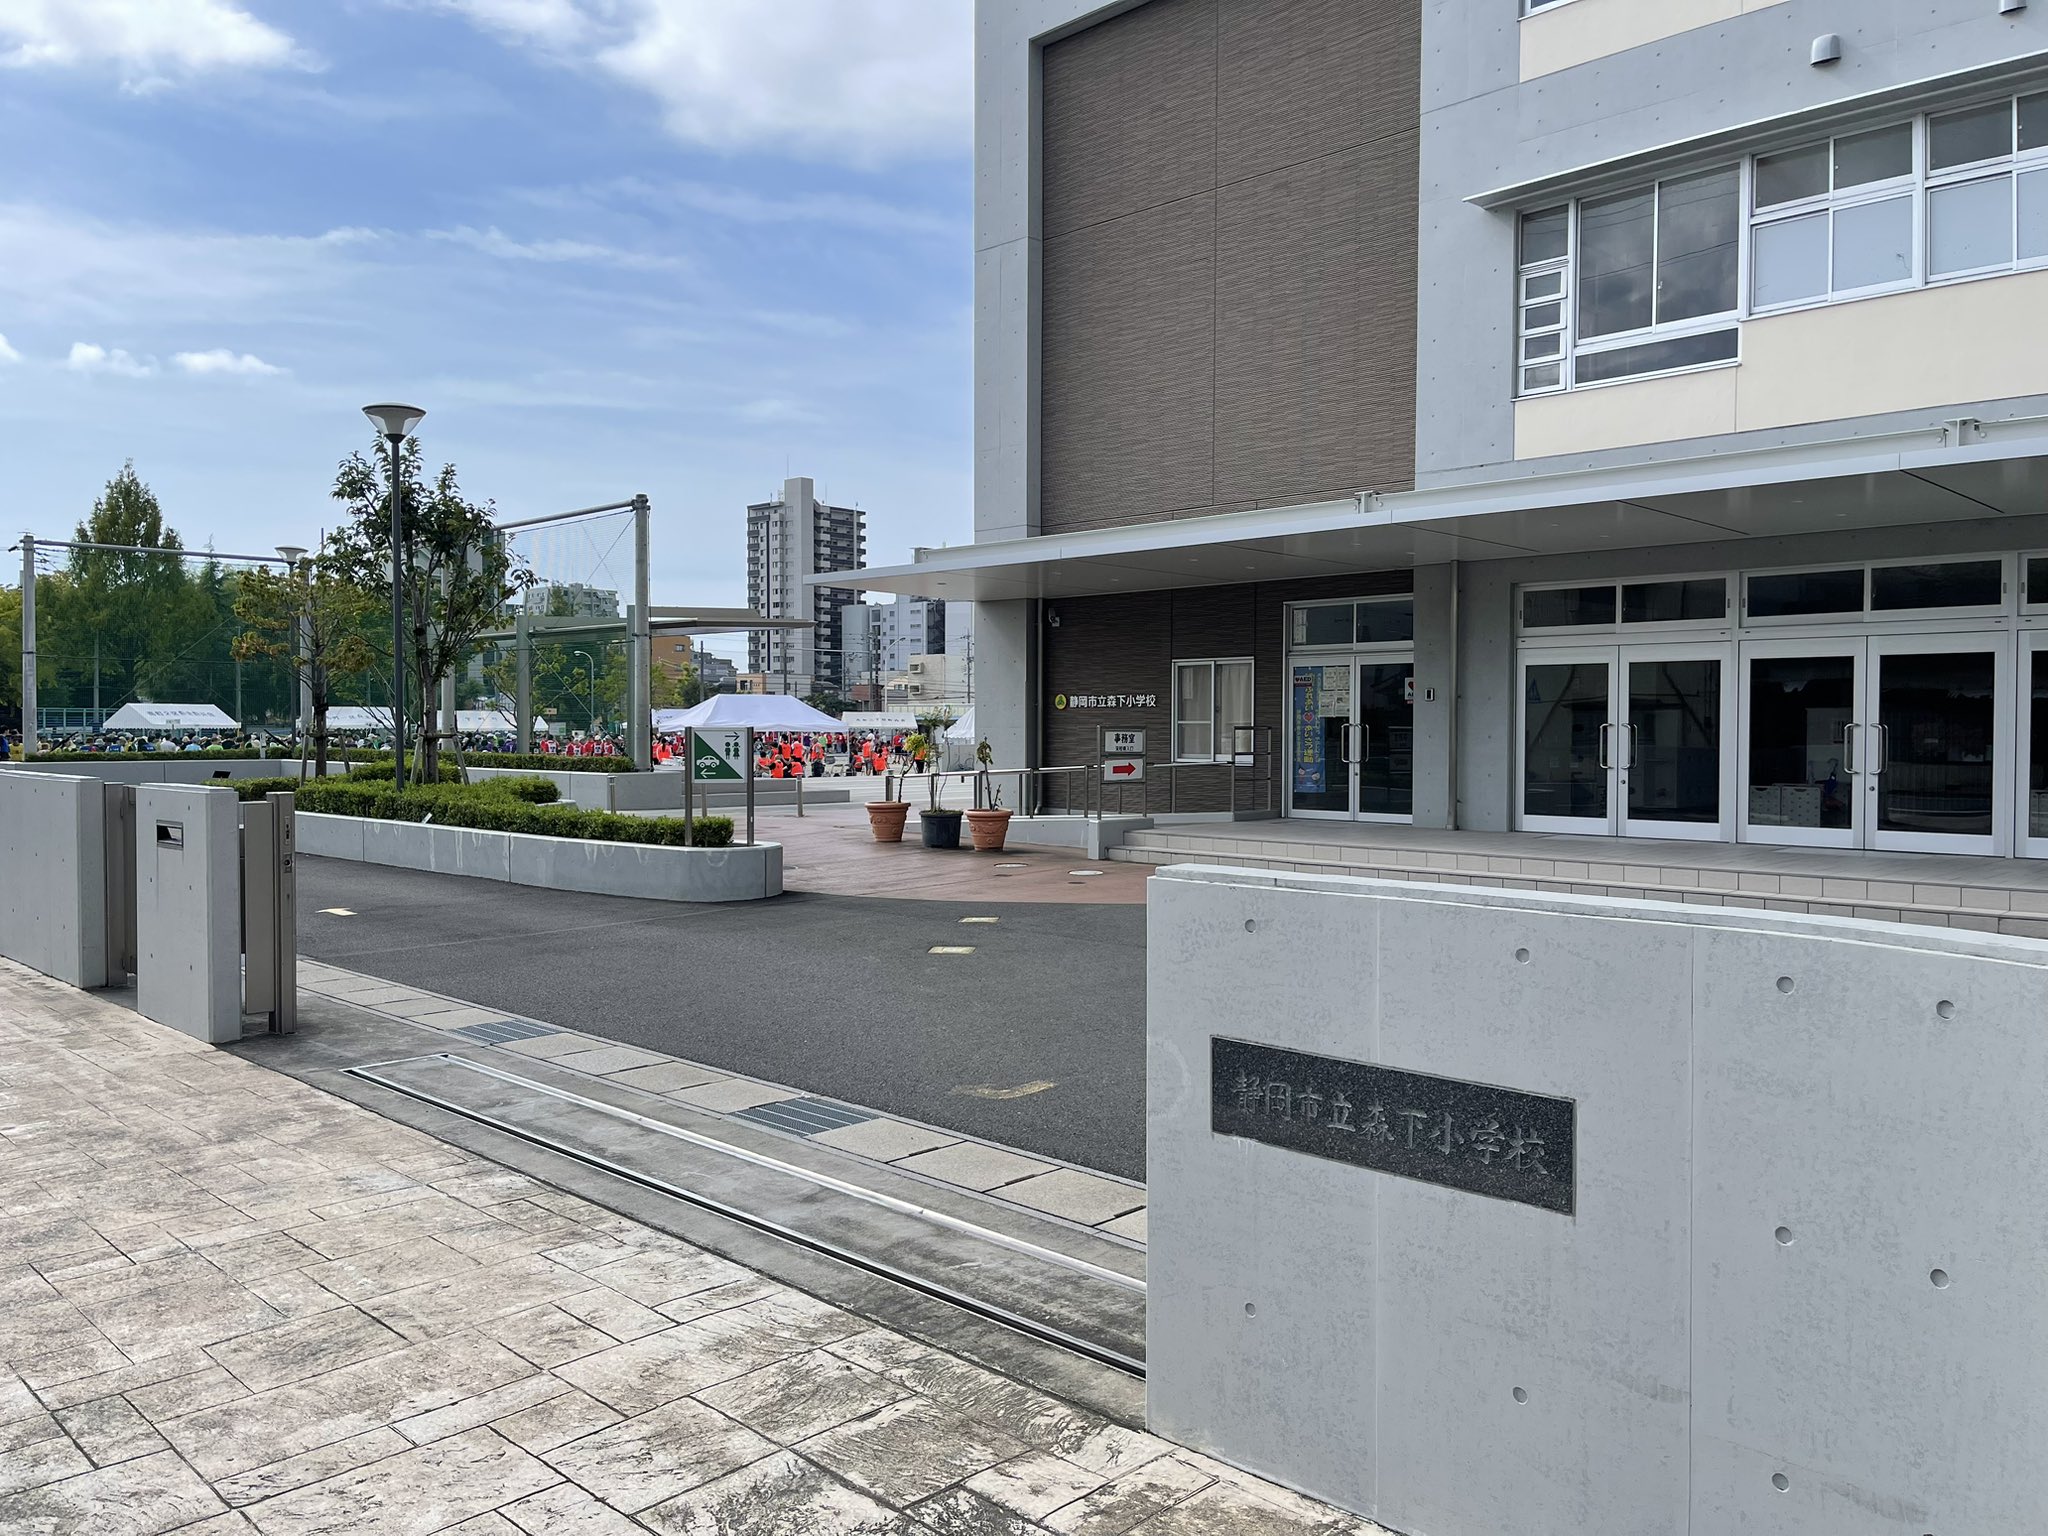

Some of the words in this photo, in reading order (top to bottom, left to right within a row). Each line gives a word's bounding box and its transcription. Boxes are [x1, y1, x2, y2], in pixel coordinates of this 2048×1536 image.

[1069, 694, 1157, 708] 静岡市立森下小学校
[1114, 733, 1136, 744] 事務室
[1231, 1070, 1549, 1174] 静岡市立森下小学校
